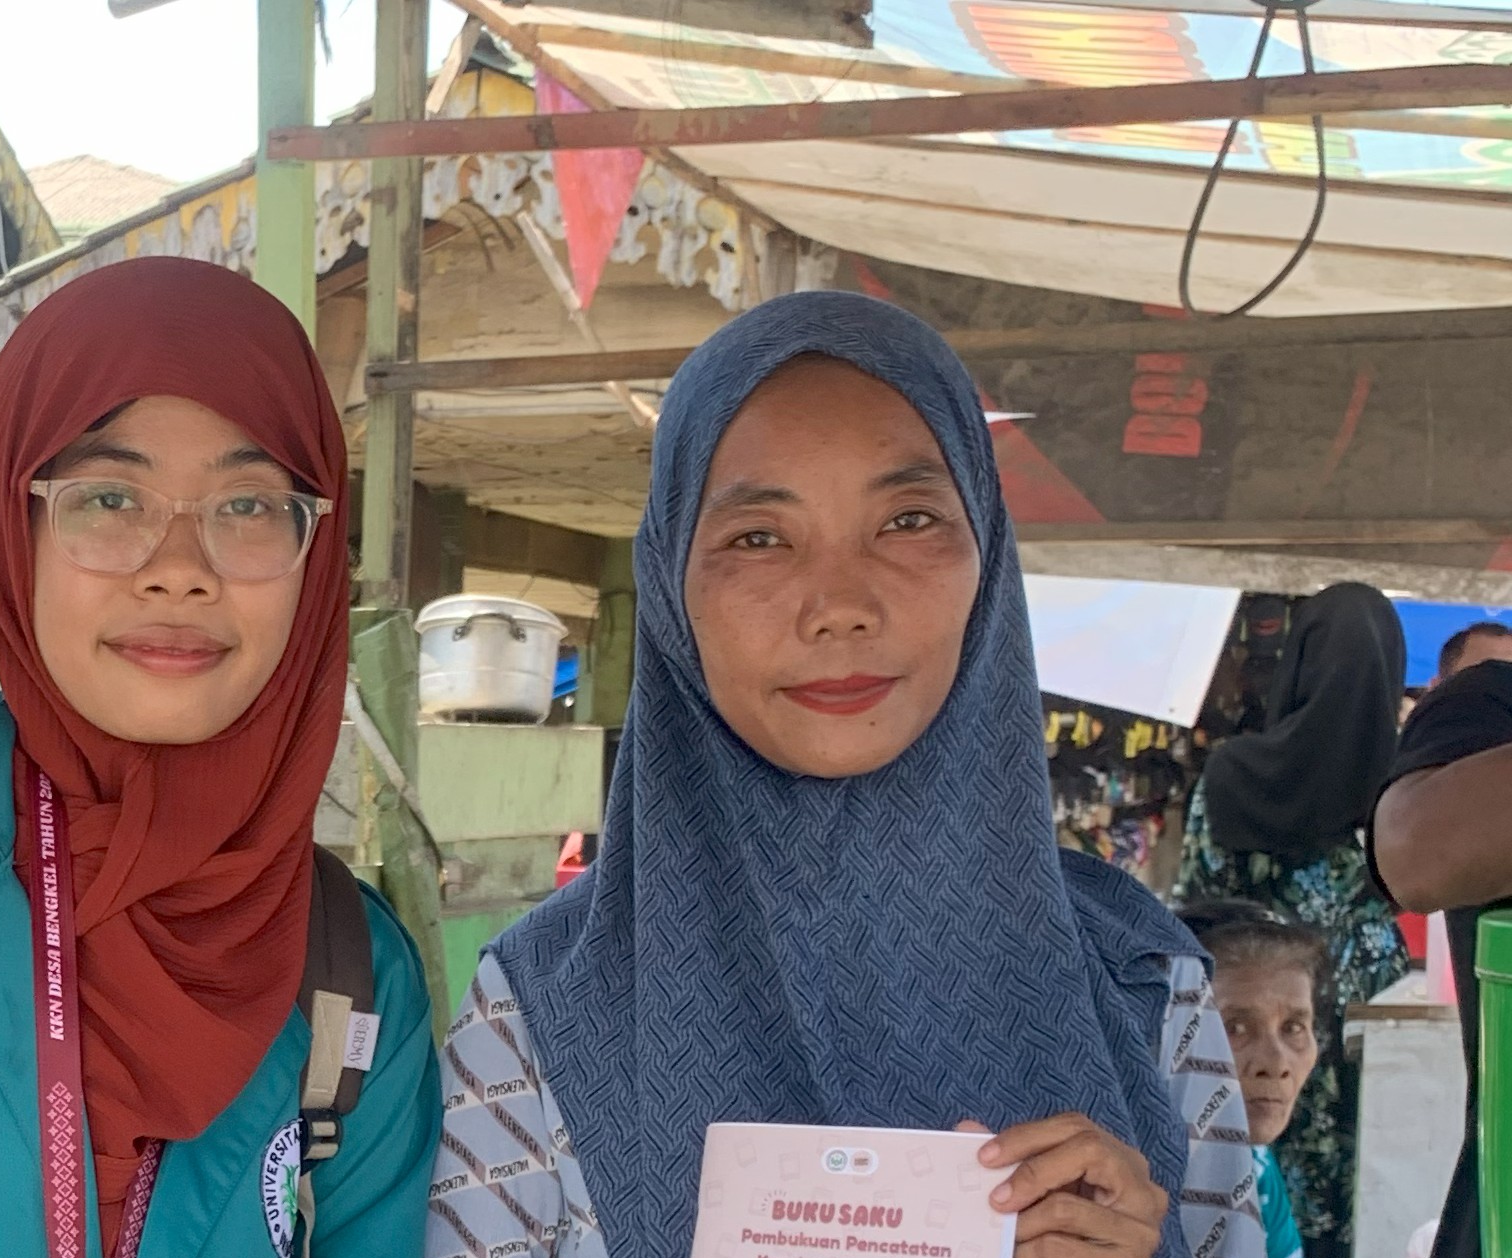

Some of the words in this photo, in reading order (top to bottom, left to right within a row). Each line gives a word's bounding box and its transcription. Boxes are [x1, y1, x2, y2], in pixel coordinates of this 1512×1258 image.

[39, 800, 56, 860] TAHUN
[43, 862, 61, 948] BENGKEL
[47, 949, 64, 998] DESA
[50, 1000, 65, 1041] KKN
[1197, 1083, 1230, 1129] VALENSIAGA
[442, 1131, 477, 1169] LENSIAGA
[494, 1105, 539, 1158] VALENSIAGA
[489, 1159, 530, 1180] VALENSIAGA
[771, 1199, 835, 1225] BUKU
[838, 1202, 904, 1229] SAKU
[741, 1228, 840, 1251] Pembukuan
[845, 1235, 952, 1258] Pencatatan
